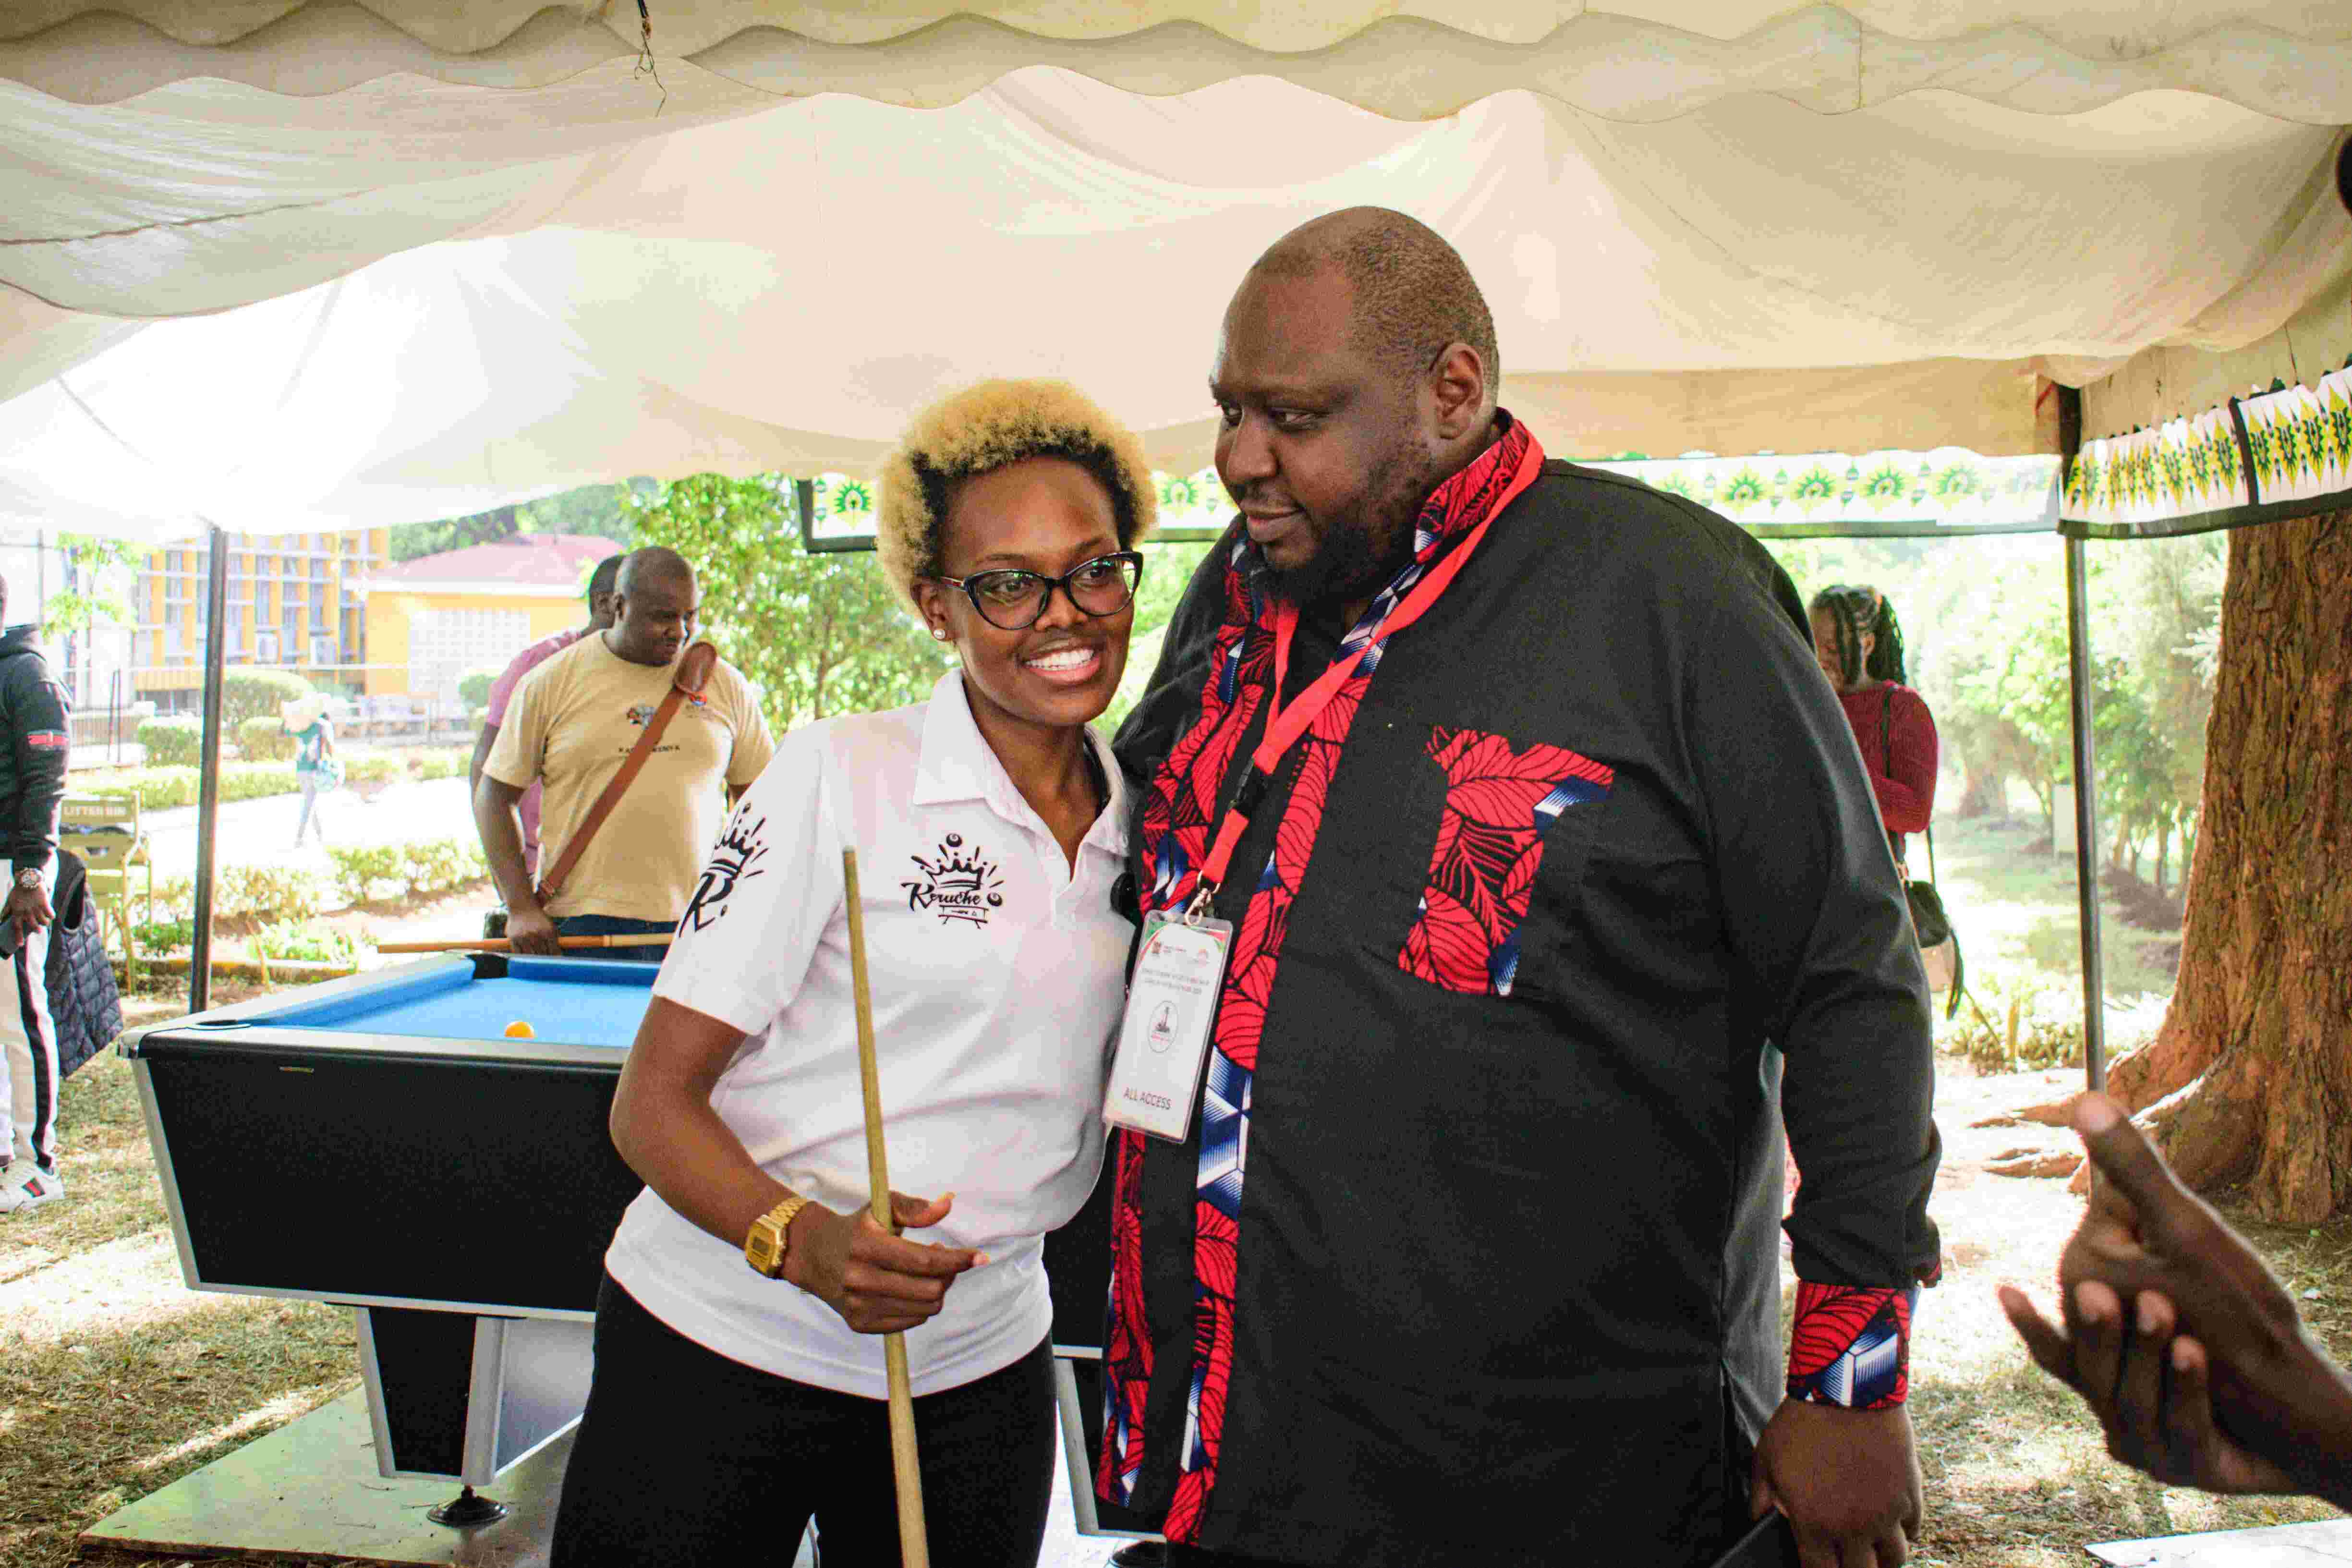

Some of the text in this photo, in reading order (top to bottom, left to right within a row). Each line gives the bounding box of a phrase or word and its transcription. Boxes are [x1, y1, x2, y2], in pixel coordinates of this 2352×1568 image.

[64, 806, 100, 815] LITTER
[1123, 1086, 1172, 1110] ALL ACCESS
